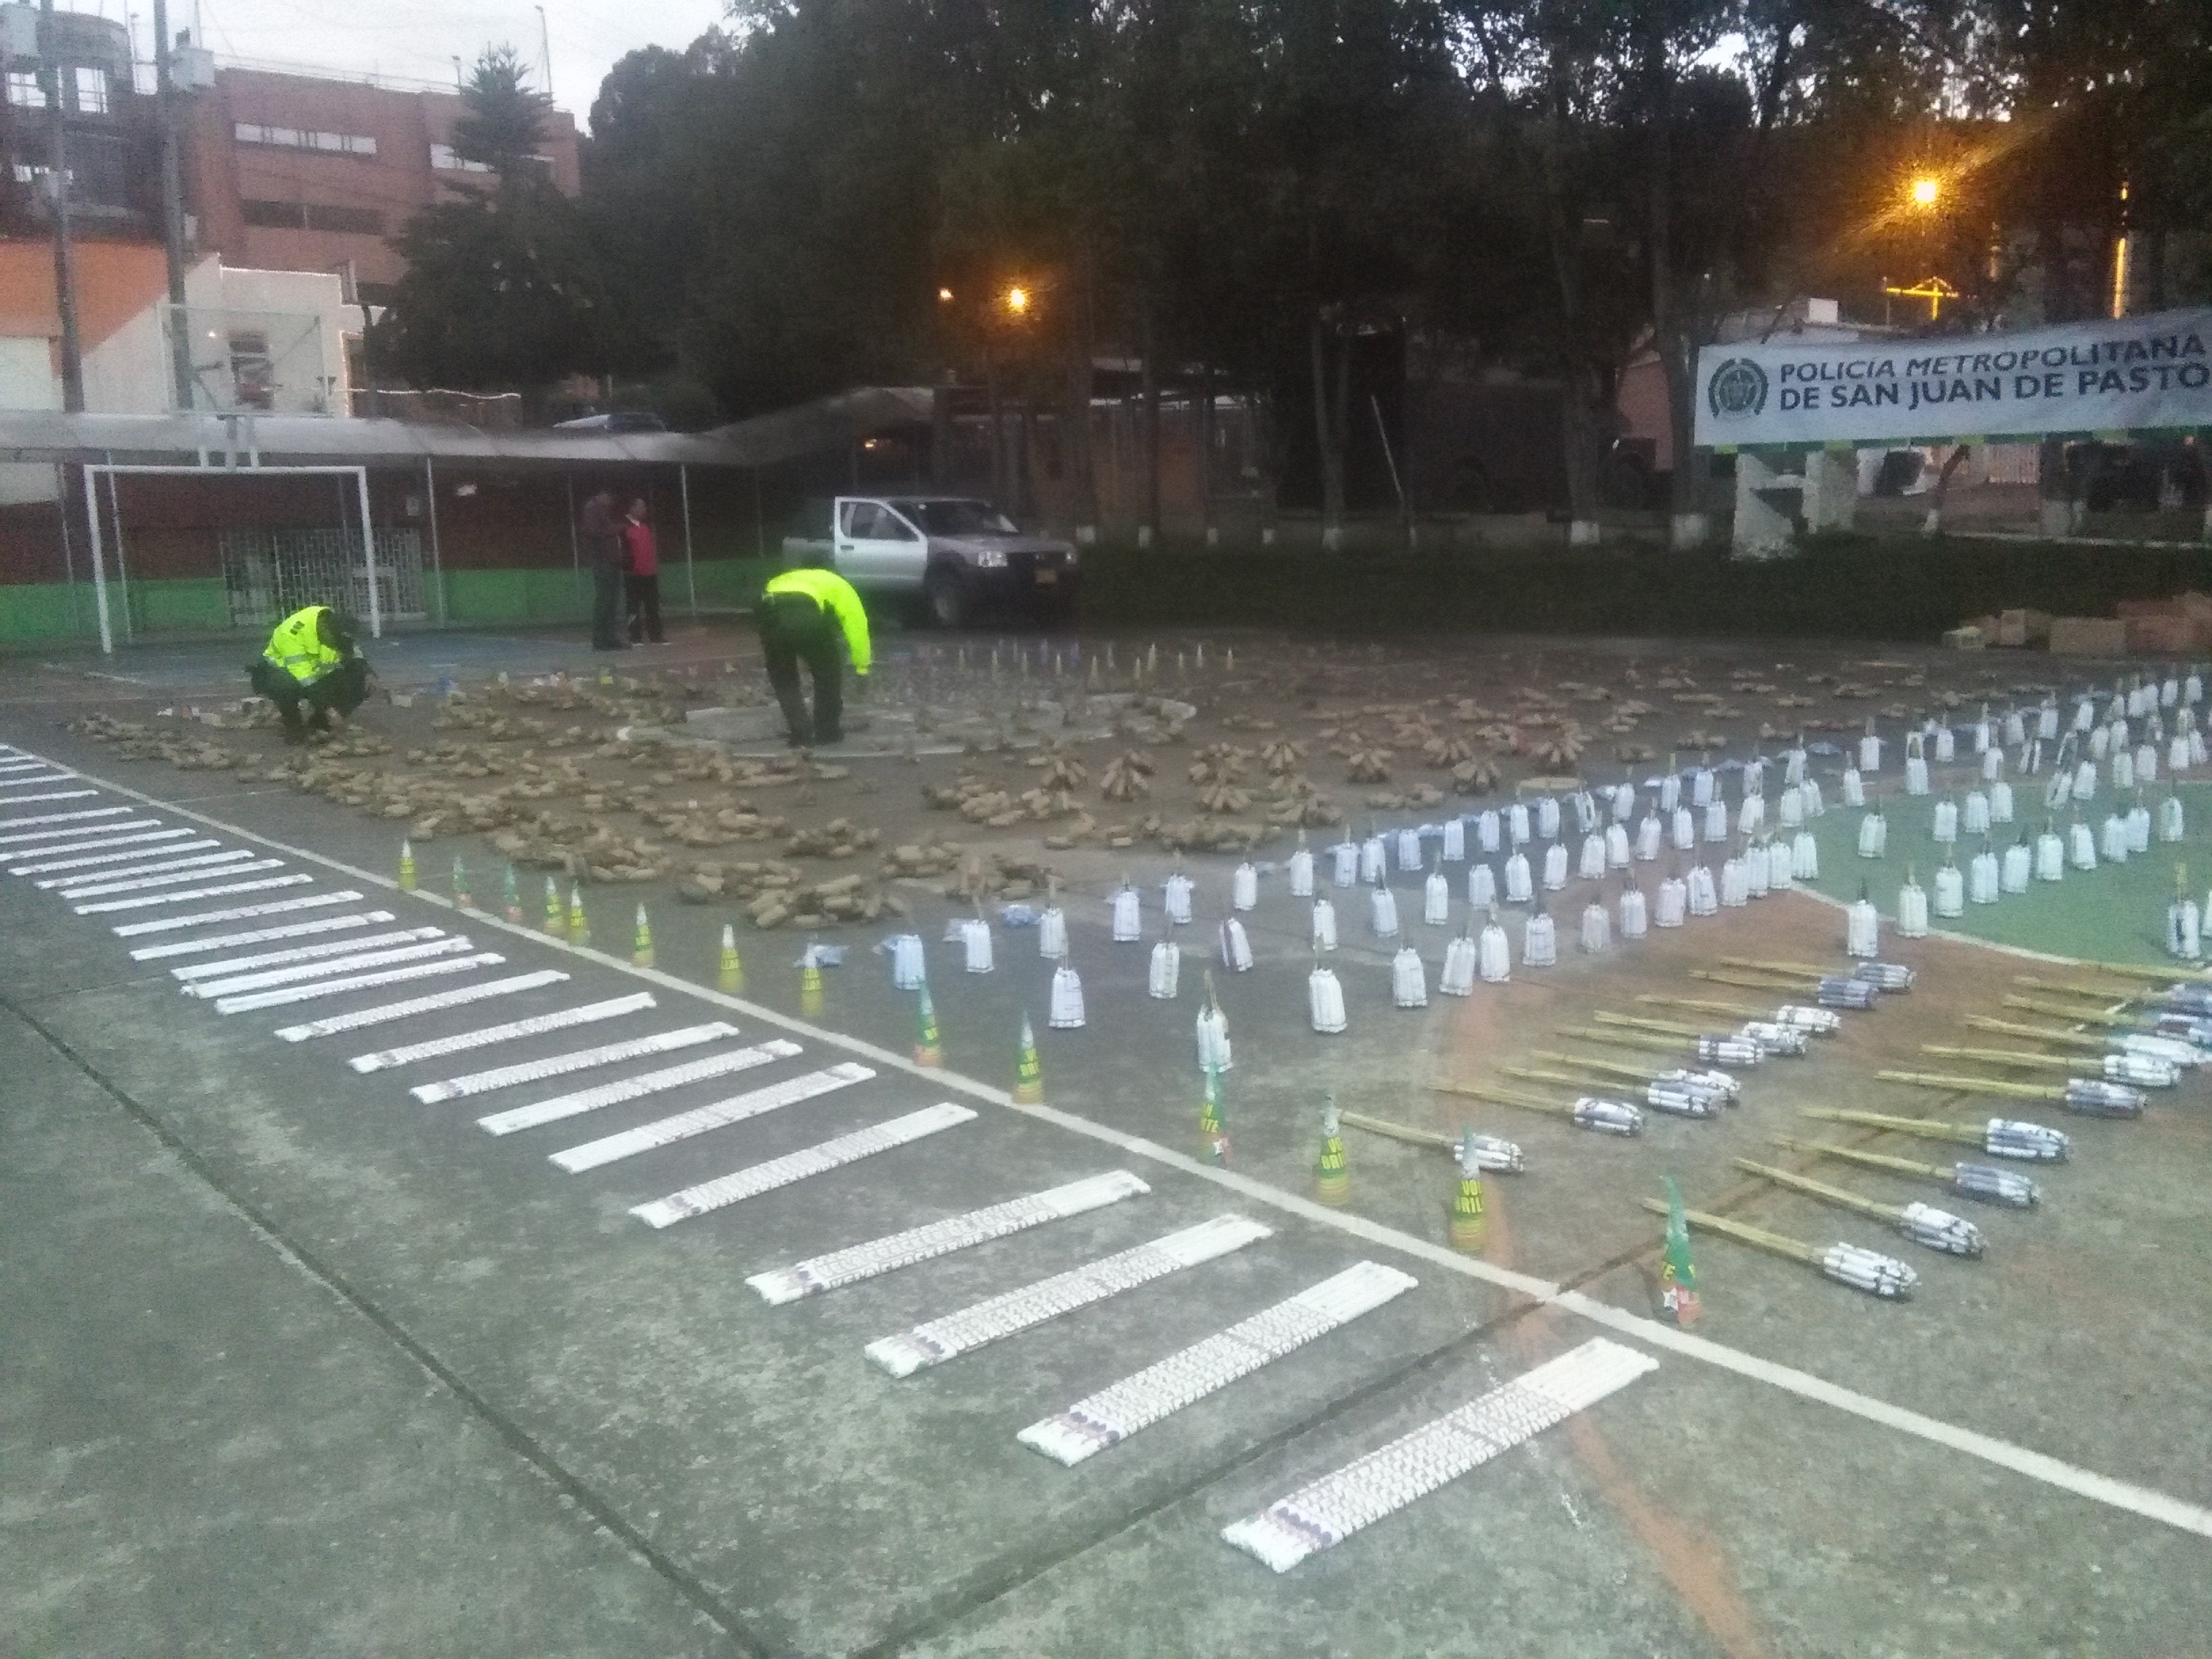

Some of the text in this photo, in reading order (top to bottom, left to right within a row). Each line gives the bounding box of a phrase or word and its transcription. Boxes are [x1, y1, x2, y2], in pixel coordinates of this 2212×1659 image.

[1906, 334, 2207, 377] METROPOLITANA
[1780, 361, 2211, 411] DE SAN JUAN DE PASTO
